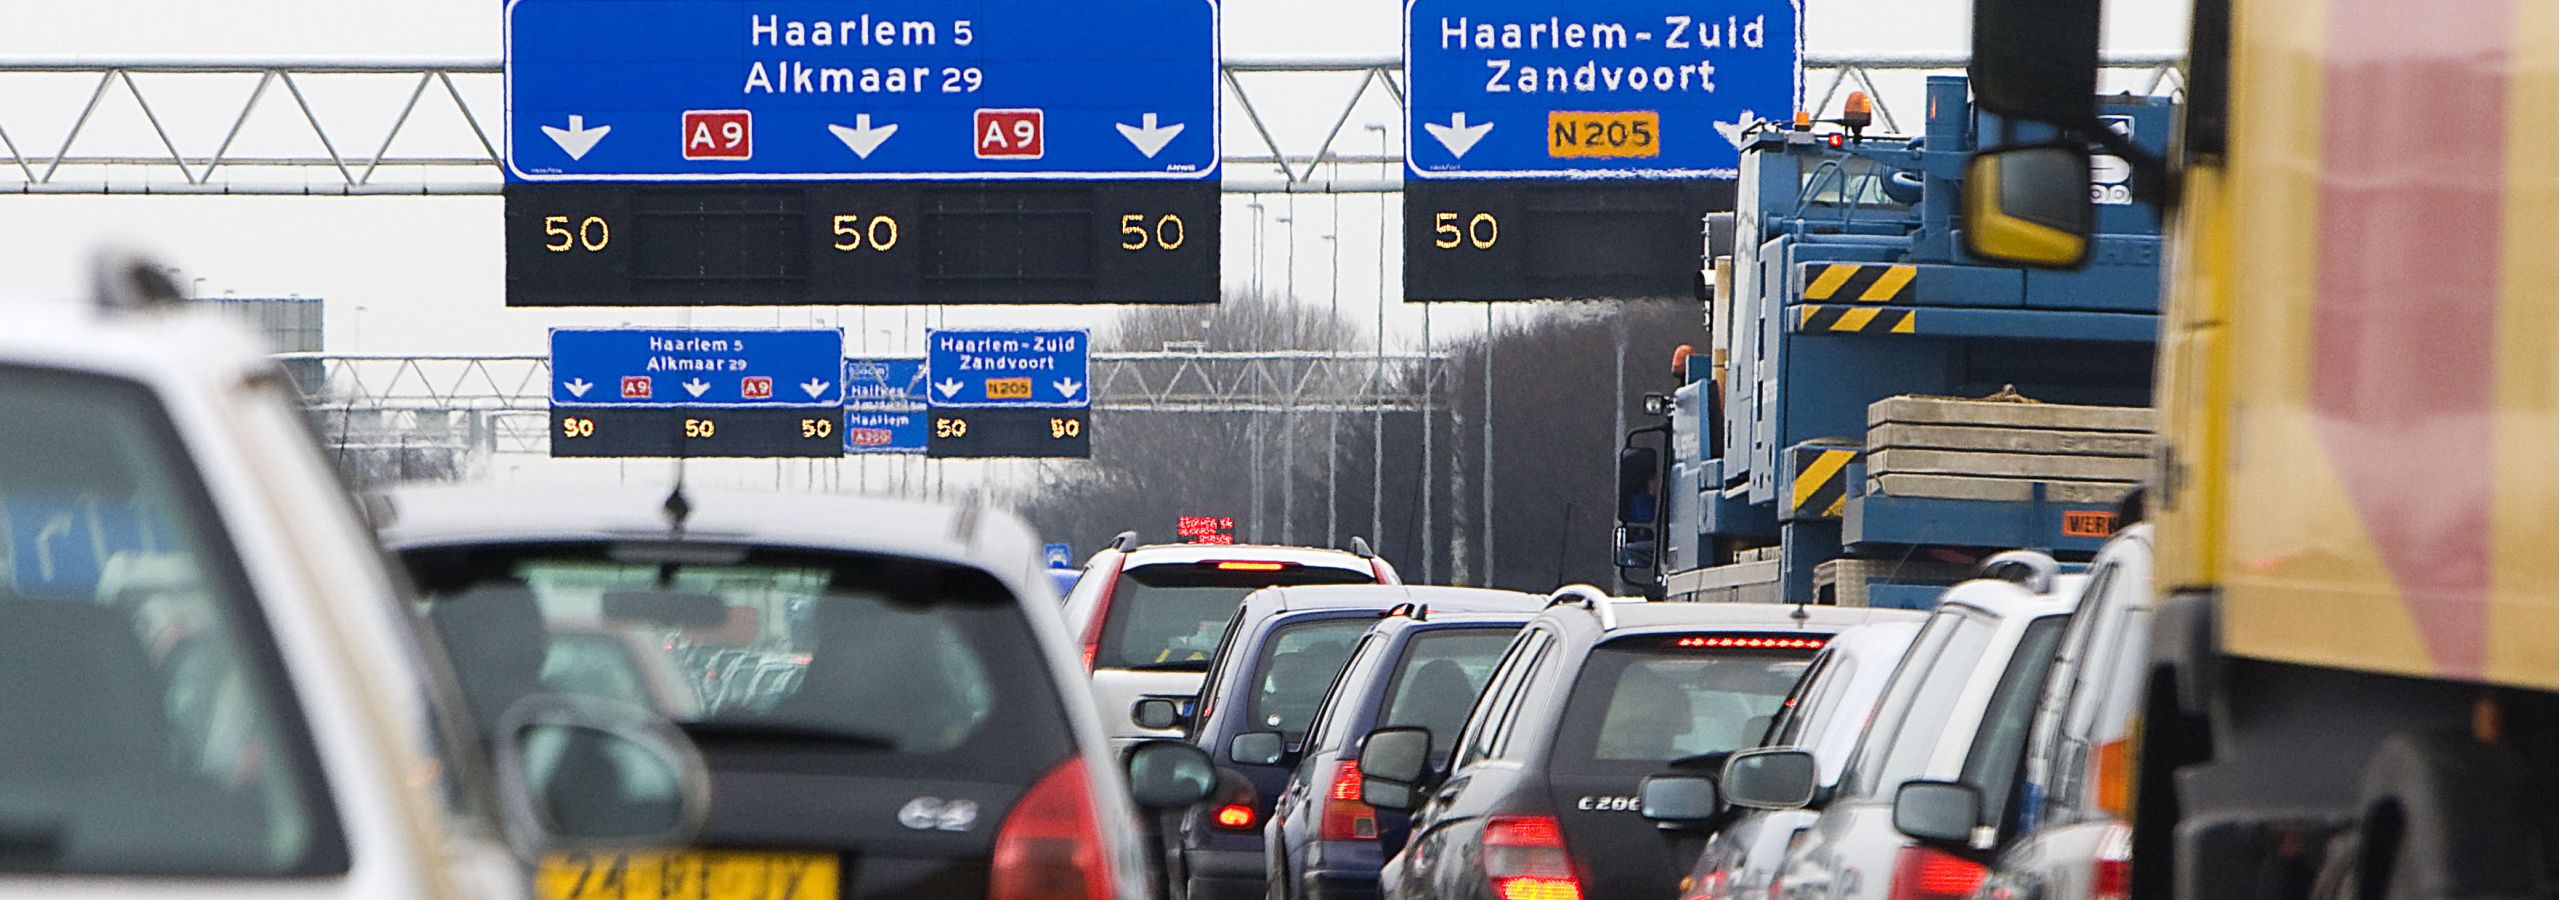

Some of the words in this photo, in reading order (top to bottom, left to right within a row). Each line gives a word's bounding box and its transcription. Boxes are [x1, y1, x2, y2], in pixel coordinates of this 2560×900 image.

[752, 13, 936, 46] Haarlem
[954, 20, 974, 47] 5
[743, 61, 930, 94] Alkmaar
[941, 67, 983, 94] 29
[1486, 59, 1716, 93] Zandvoort
[545, 215, 609, 252] 50
[833, 214, 898, 252] 50
[1121, 213, 1184, 251] 50
[1436, 212, 1498, 250] 50
[650, 336, 728, 352] Haarlem
[733, 340, 744, 352] 5
[646, 355, 725, 372] Alkmaar
[728, 359, 748, 371] 29
[959, 354, 1054, 370] Zandvoort
[625, 381, 648, 394] A9
[745, 380, 768, 395] A9
[685, 418, 715, 438] 50
[801, 418, 832, 438] 50
[851, 413, 909, 427] Haarlem
[936, 417, 967, 438] 50
[1050, 417, 1080, 439] 50
